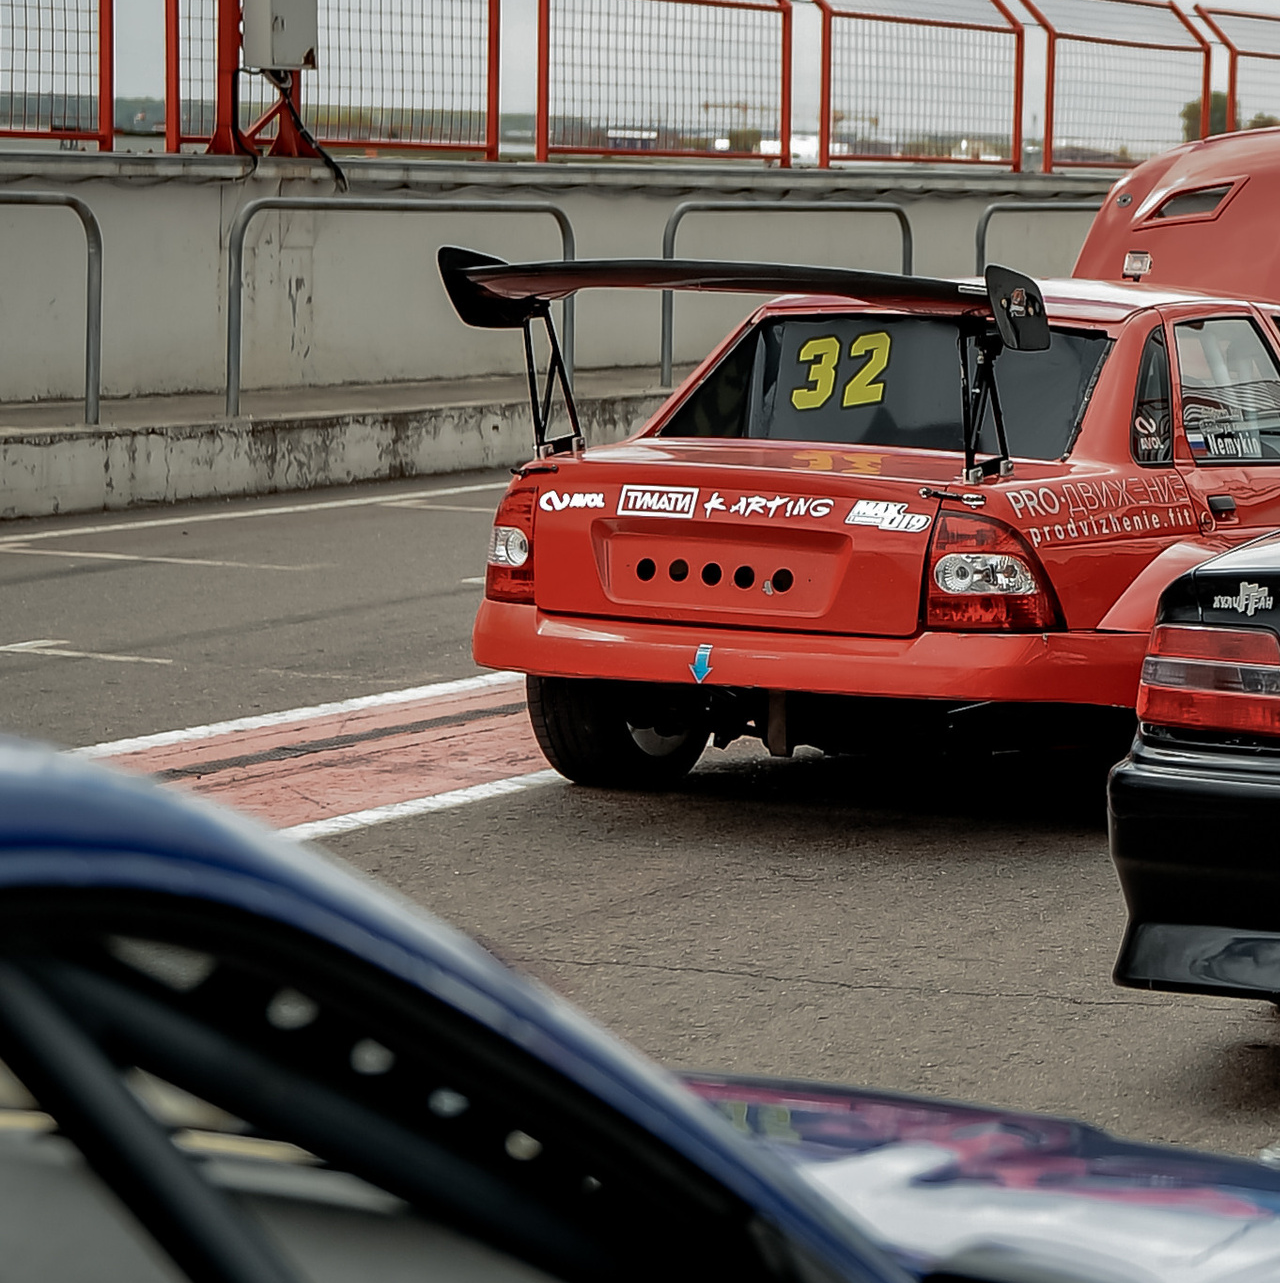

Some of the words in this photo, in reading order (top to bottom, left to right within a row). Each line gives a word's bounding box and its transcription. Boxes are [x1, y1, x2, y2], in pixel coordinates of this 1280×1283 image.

[791, 331, 891, 410] 32
[1206, 431, 1261, 457] Nemykin
[1029, 508, 1192, 547] prodvizhenie.fit
